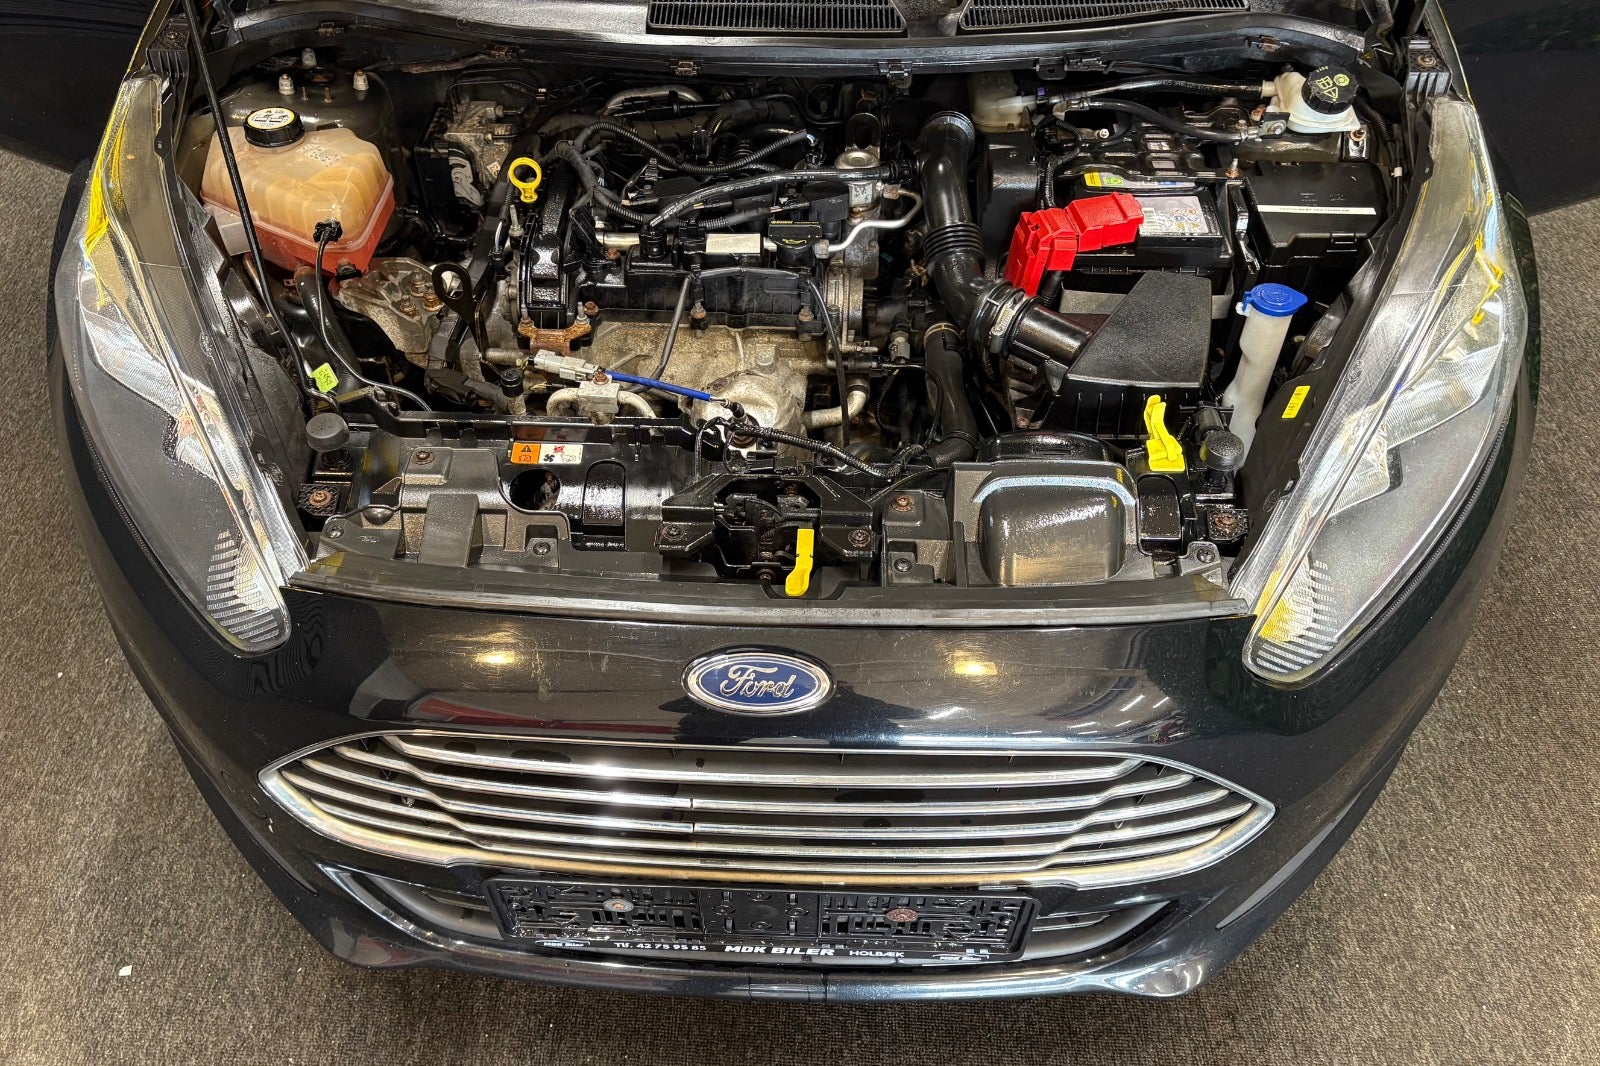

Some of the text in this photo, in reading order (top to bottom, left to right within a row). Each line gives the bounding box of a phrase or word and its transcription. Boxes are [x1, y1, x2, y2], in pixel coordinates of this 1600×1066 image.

[720, 664, 797, 698] Ford
[724, 945, 836, 956] MDK BILER
